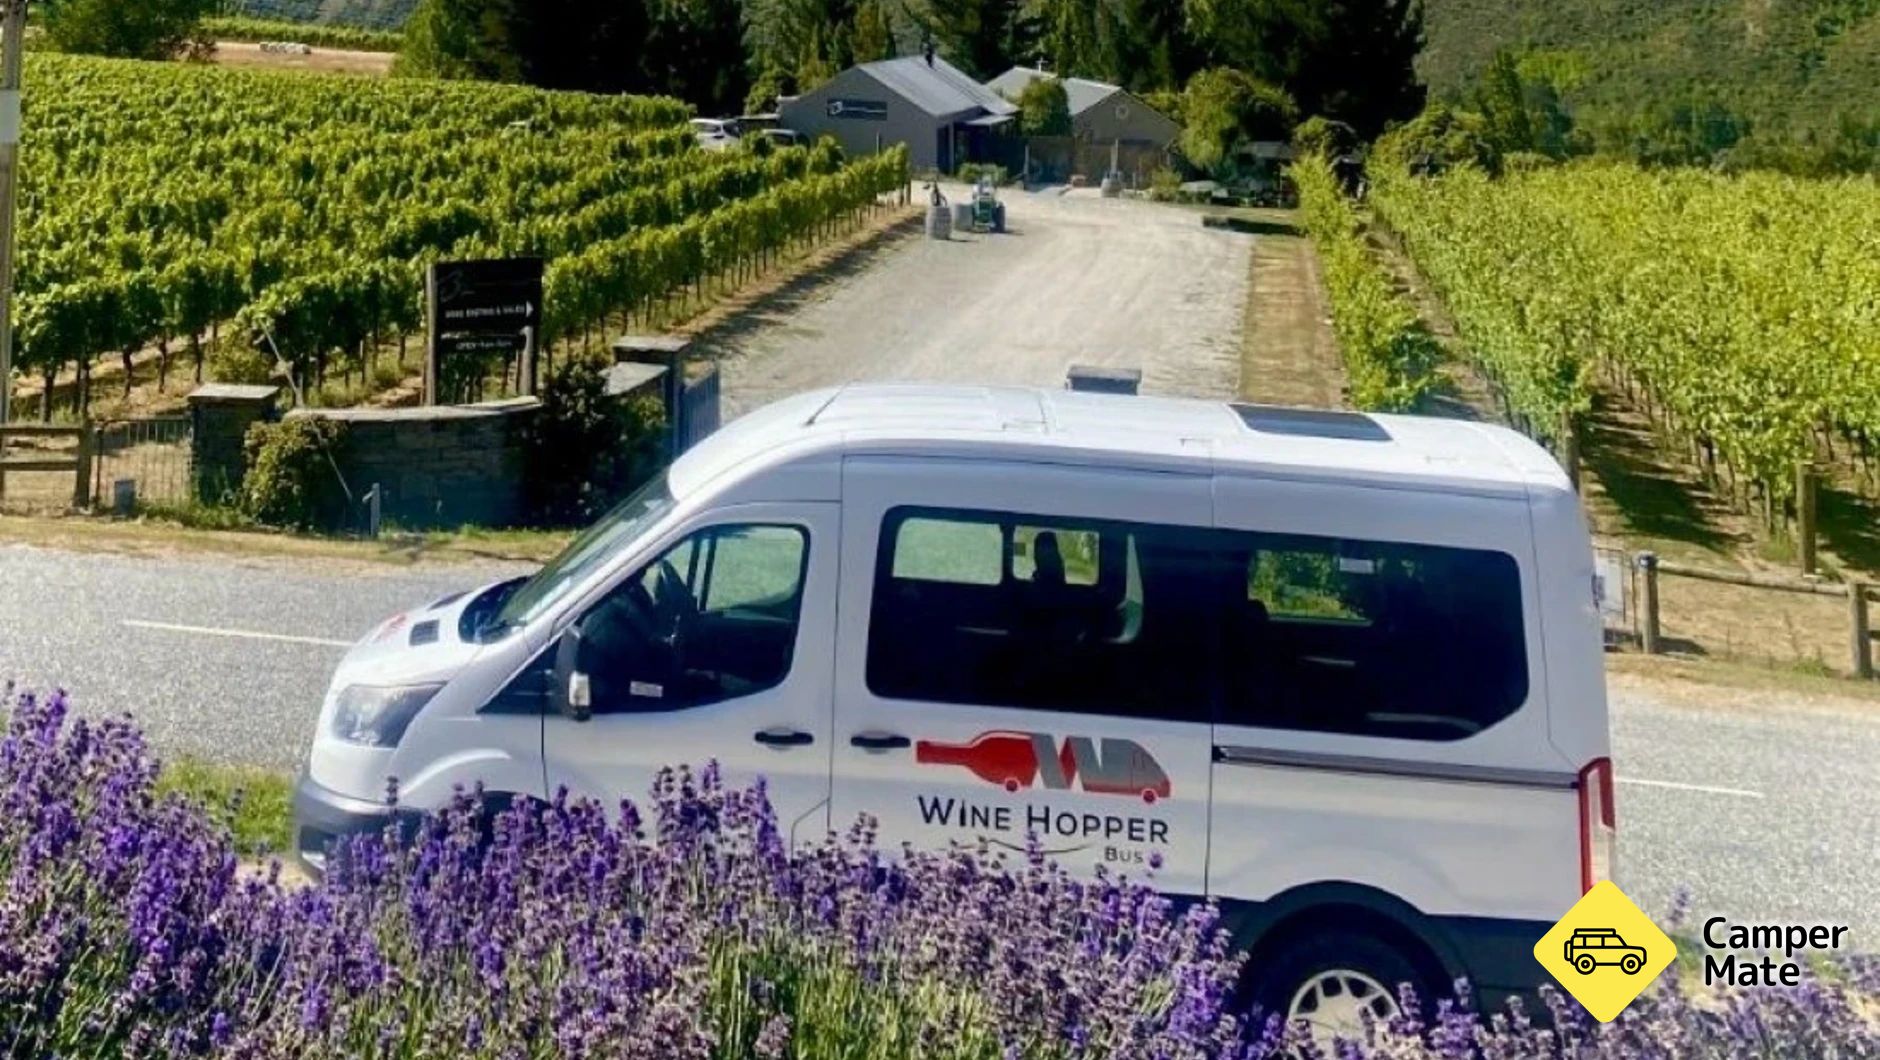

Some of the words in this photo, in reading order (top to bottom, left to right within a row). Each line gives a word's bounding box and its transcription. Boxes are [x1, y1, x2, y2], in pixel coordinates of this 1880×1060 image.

[918, 796, 1010, 830] WINE
[1026, 805, 1168, 844] HOPPER
[1104, 848, 1143, 863] BUS
